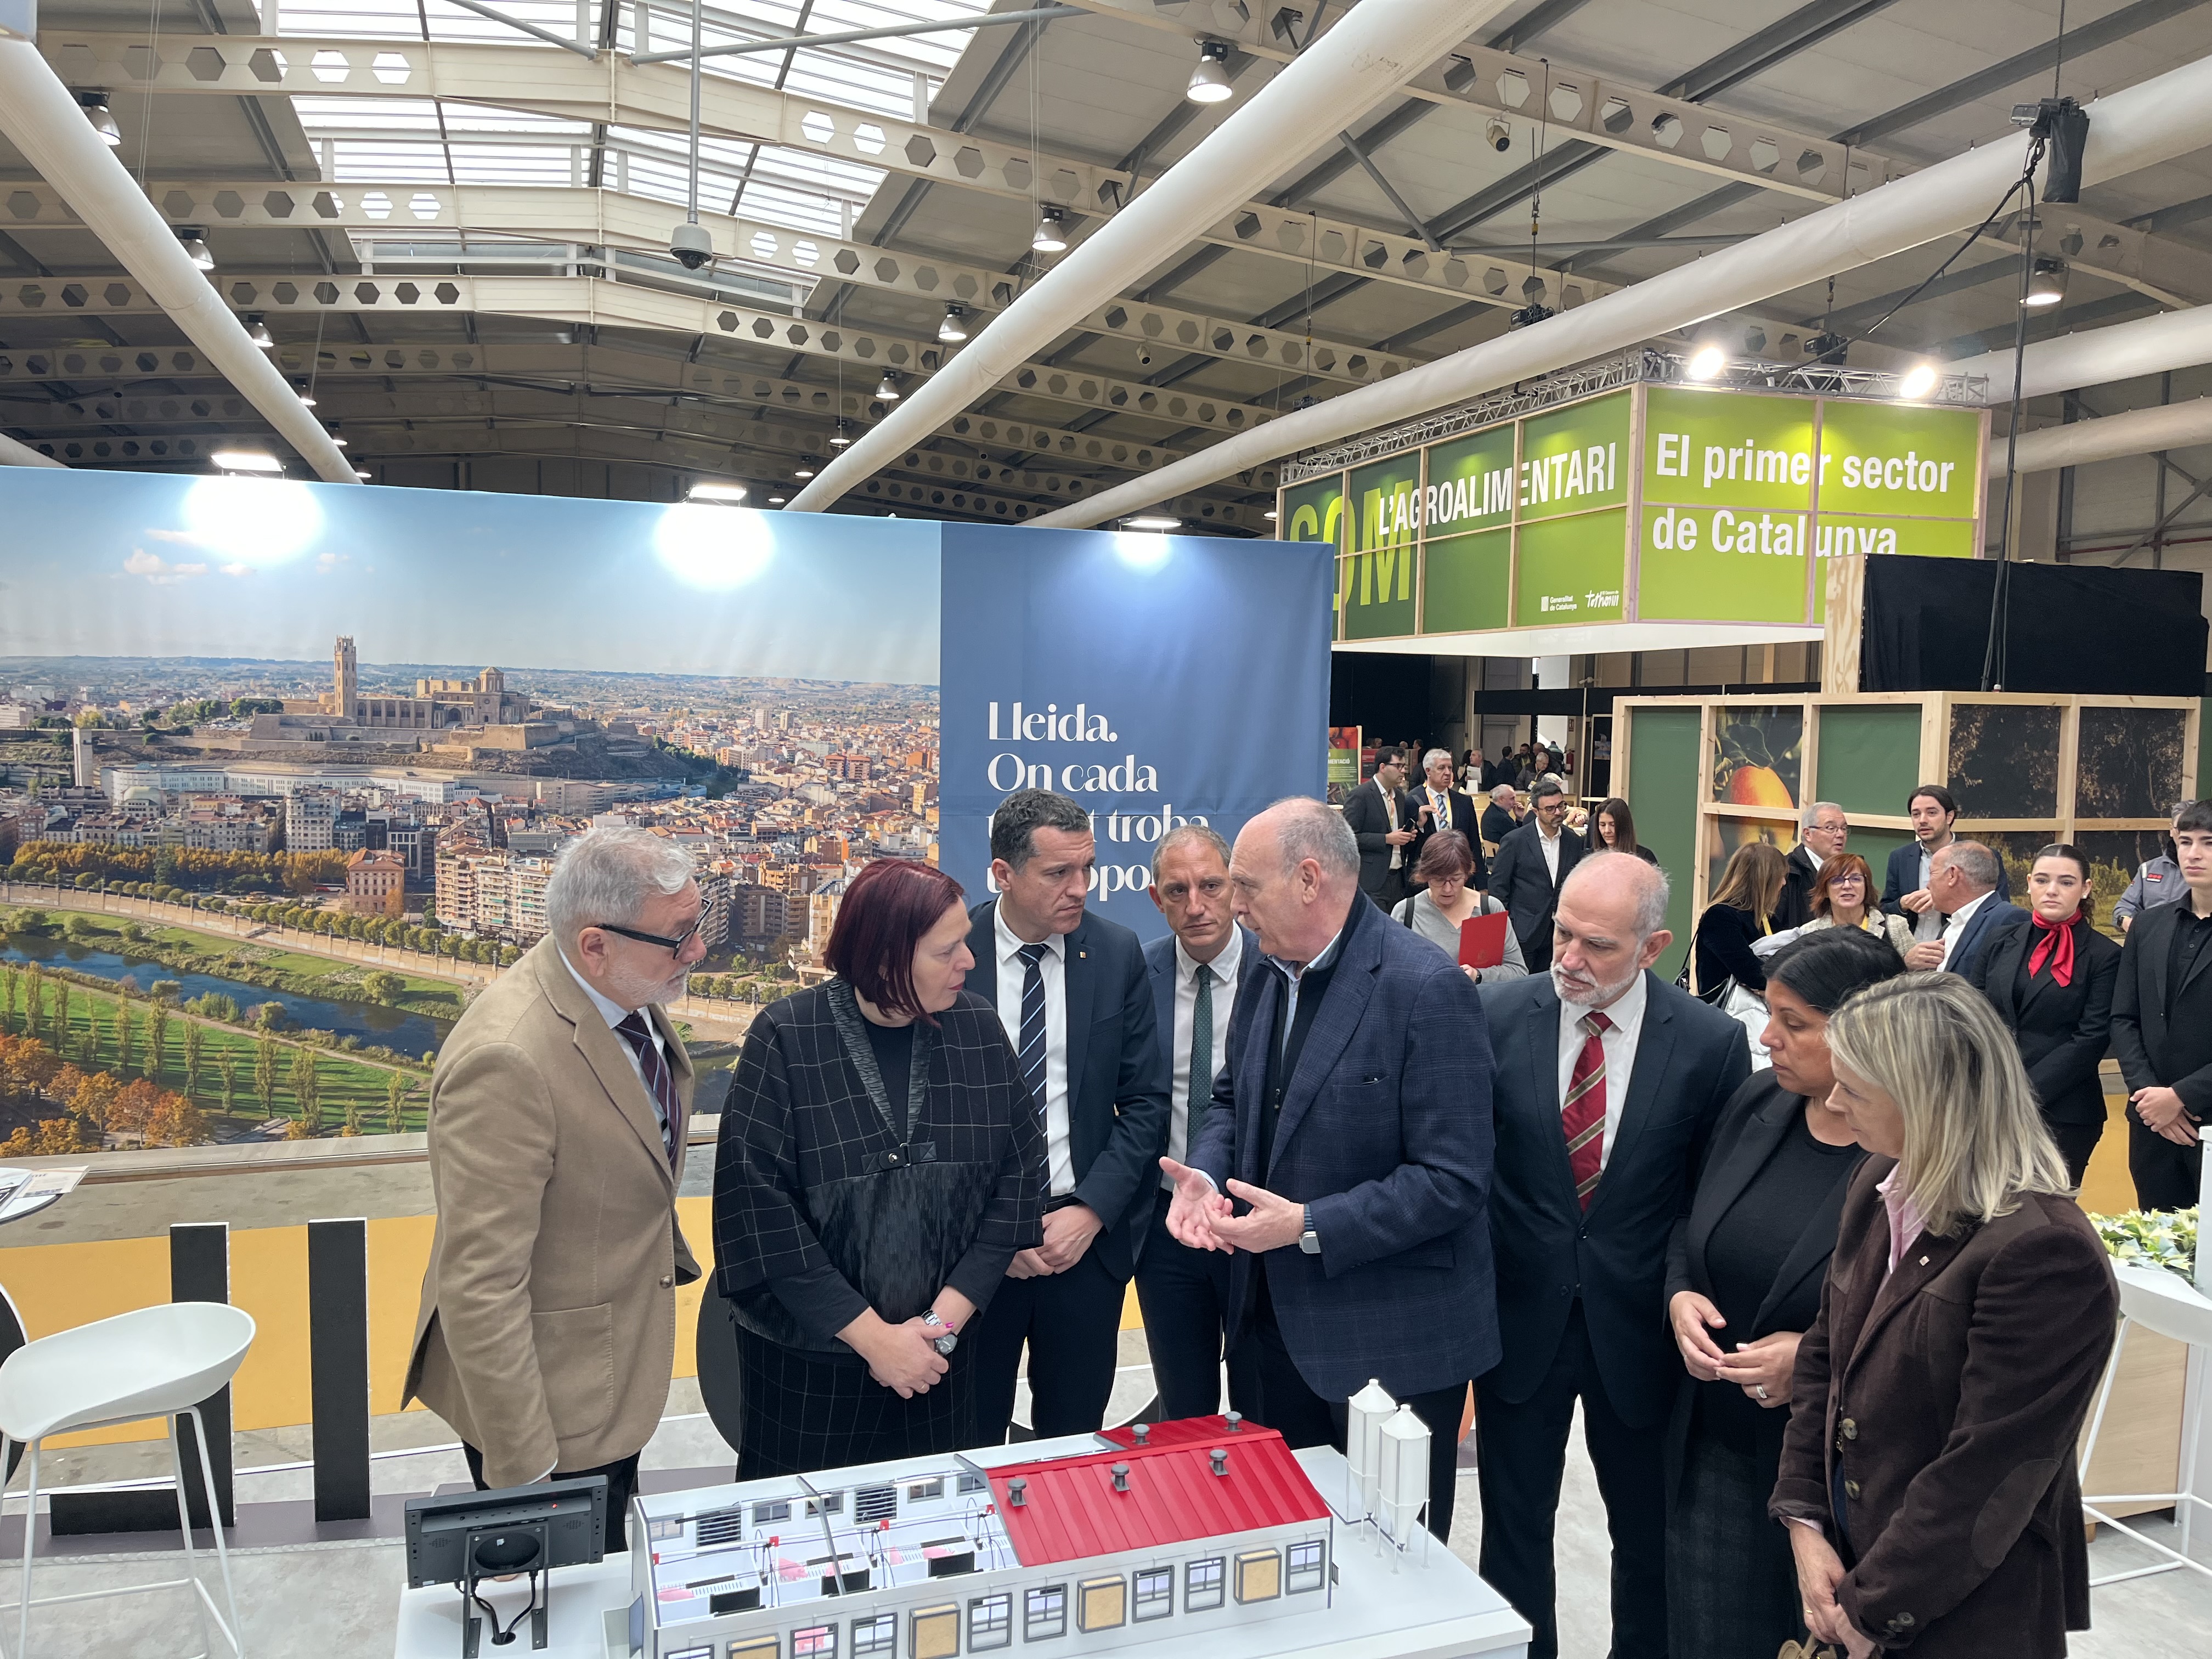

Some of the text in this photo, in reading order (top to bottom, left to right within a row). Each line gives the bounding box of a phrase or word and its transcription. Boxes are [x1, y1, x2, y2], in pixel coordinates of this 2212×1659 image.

[1656, 433, 1954, 492] El primer sector
[1379, 442, 1616, 535] L'AGROALIMENTARI
[1653, 507, 1896, 557] de Catalunya
[1556, 603, 1577, 611] Catalunya
[989, 702, 1118, 742] Lleida.
[988, 753, 1159, 792] On cada
